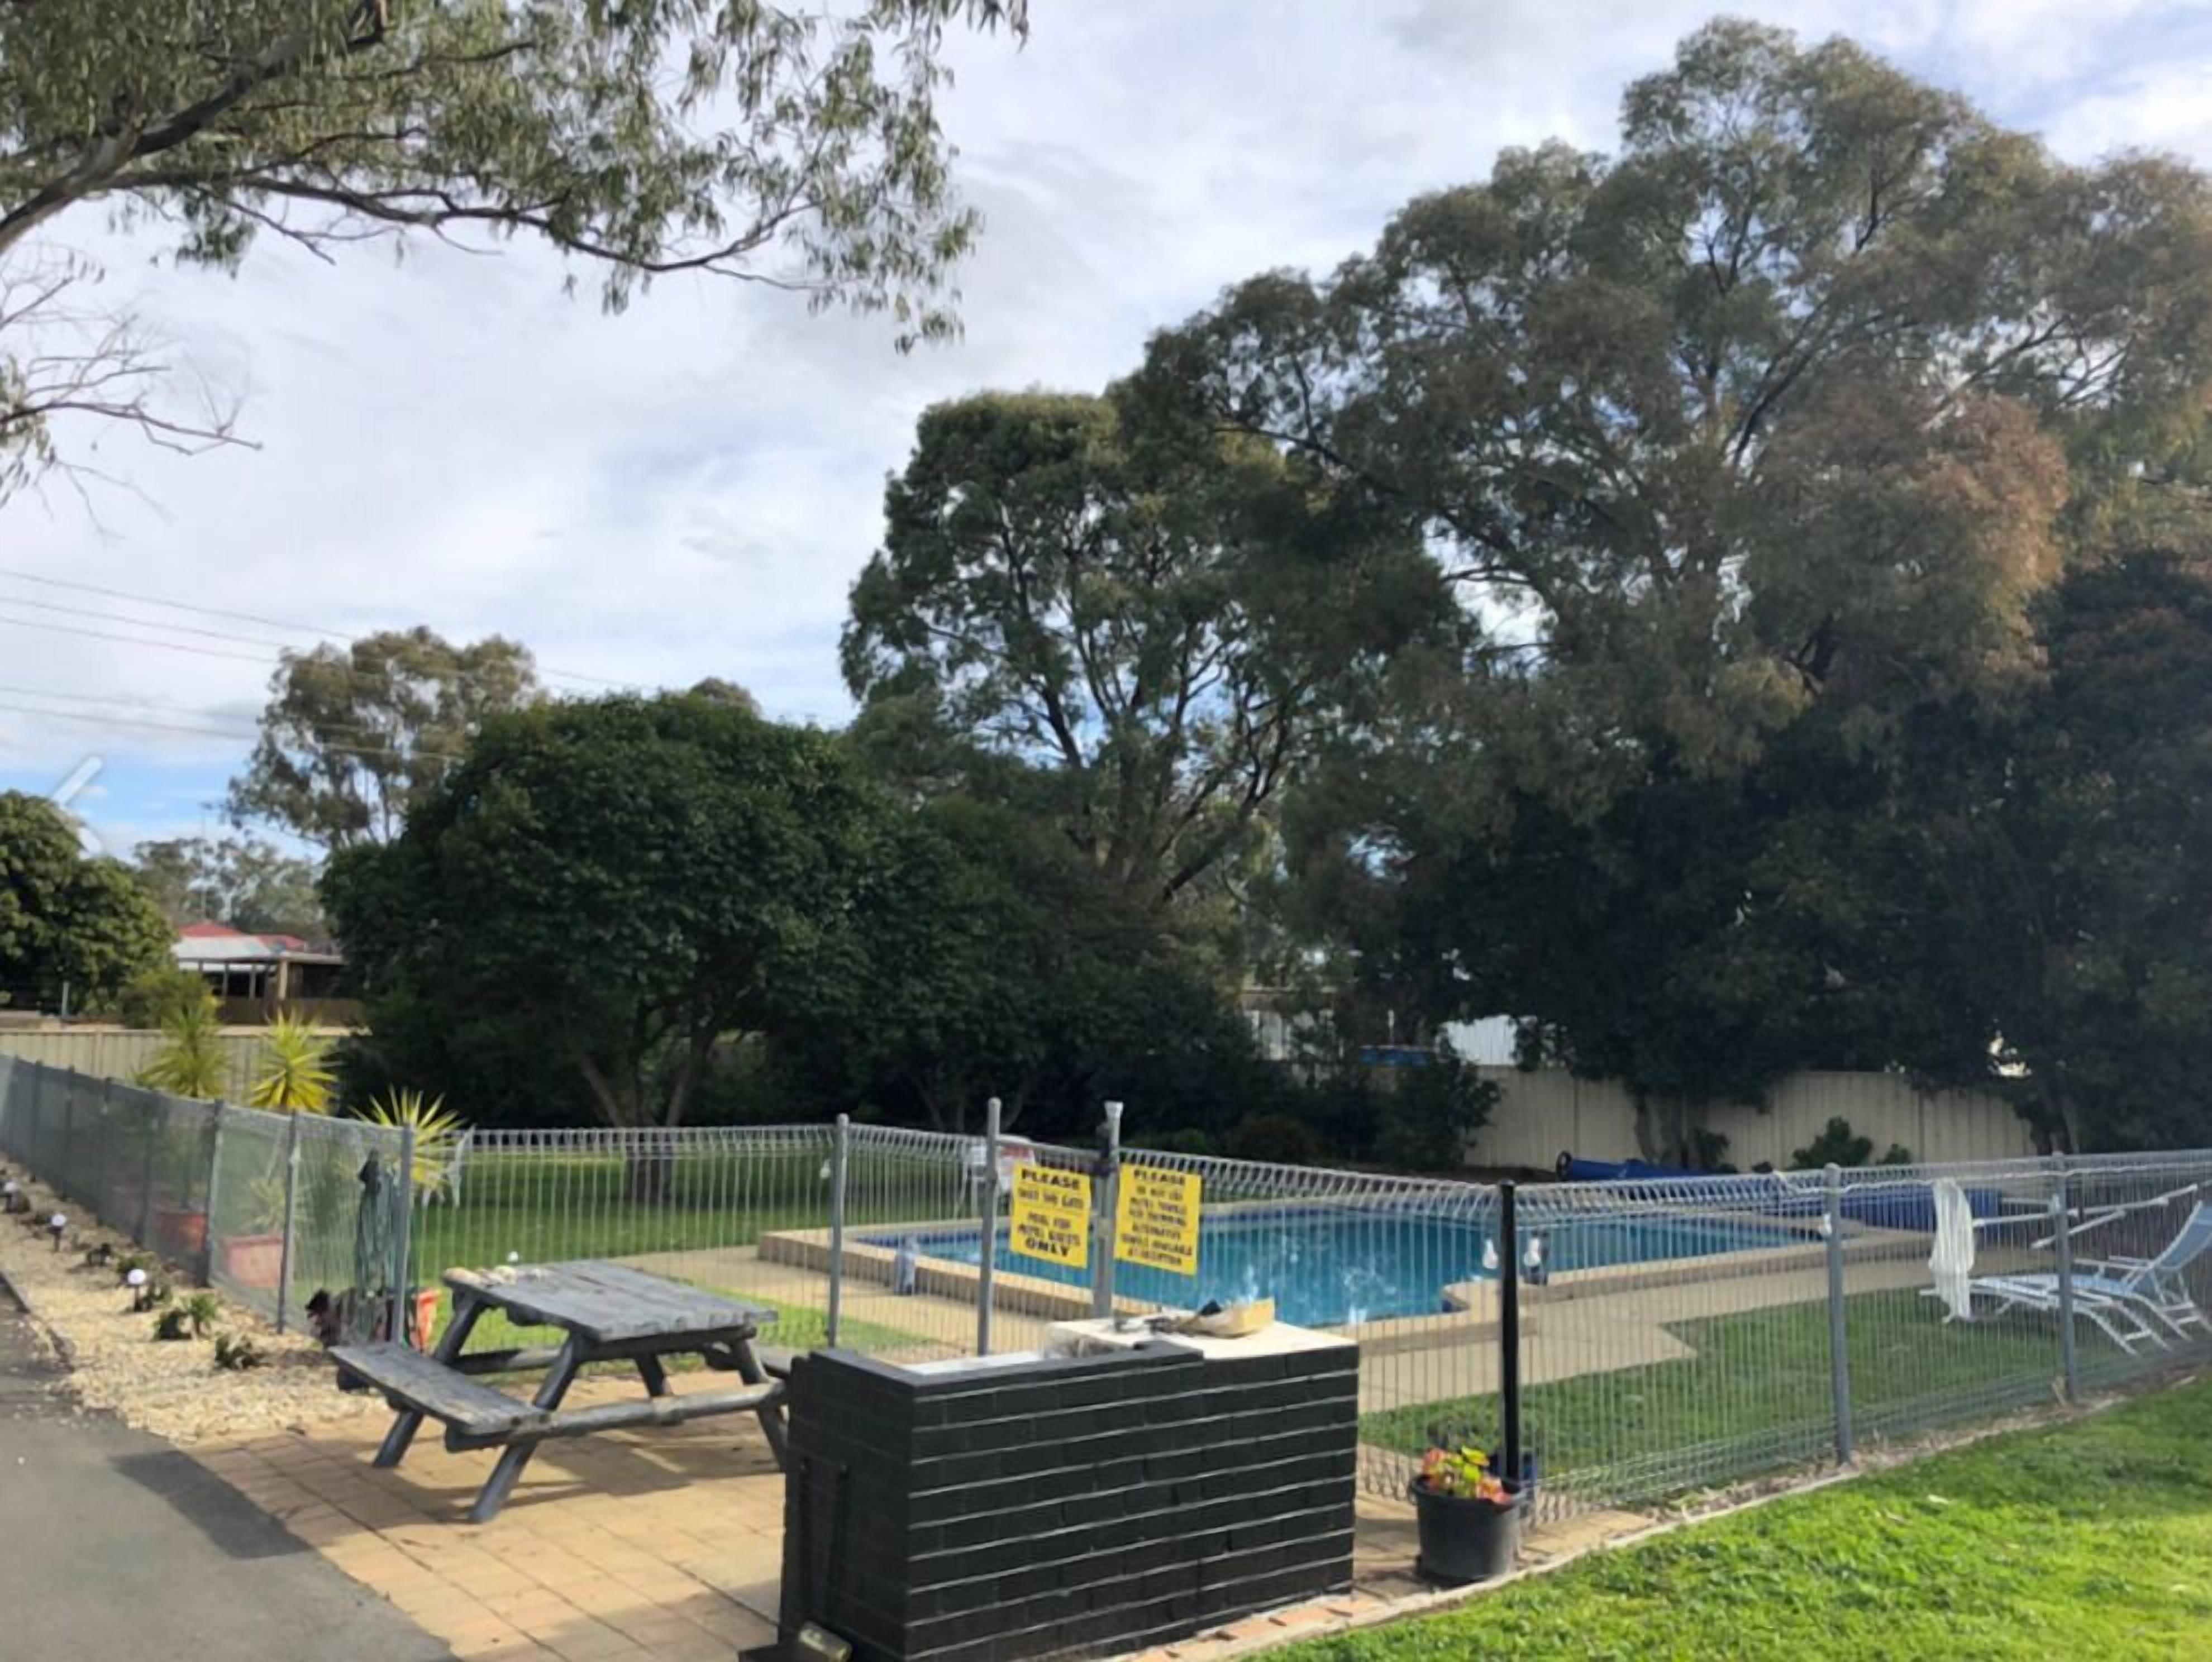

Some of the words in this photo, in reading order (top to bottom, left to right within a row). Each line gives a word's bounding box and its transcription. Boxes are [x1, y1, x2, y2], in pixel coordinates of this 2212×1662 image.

[1021, 1168, 1080, 1191] PLEASE
[1133, 1169, 1185, 1186] PLEASE
[1025, 1237, 1069, 1257] ONLY
